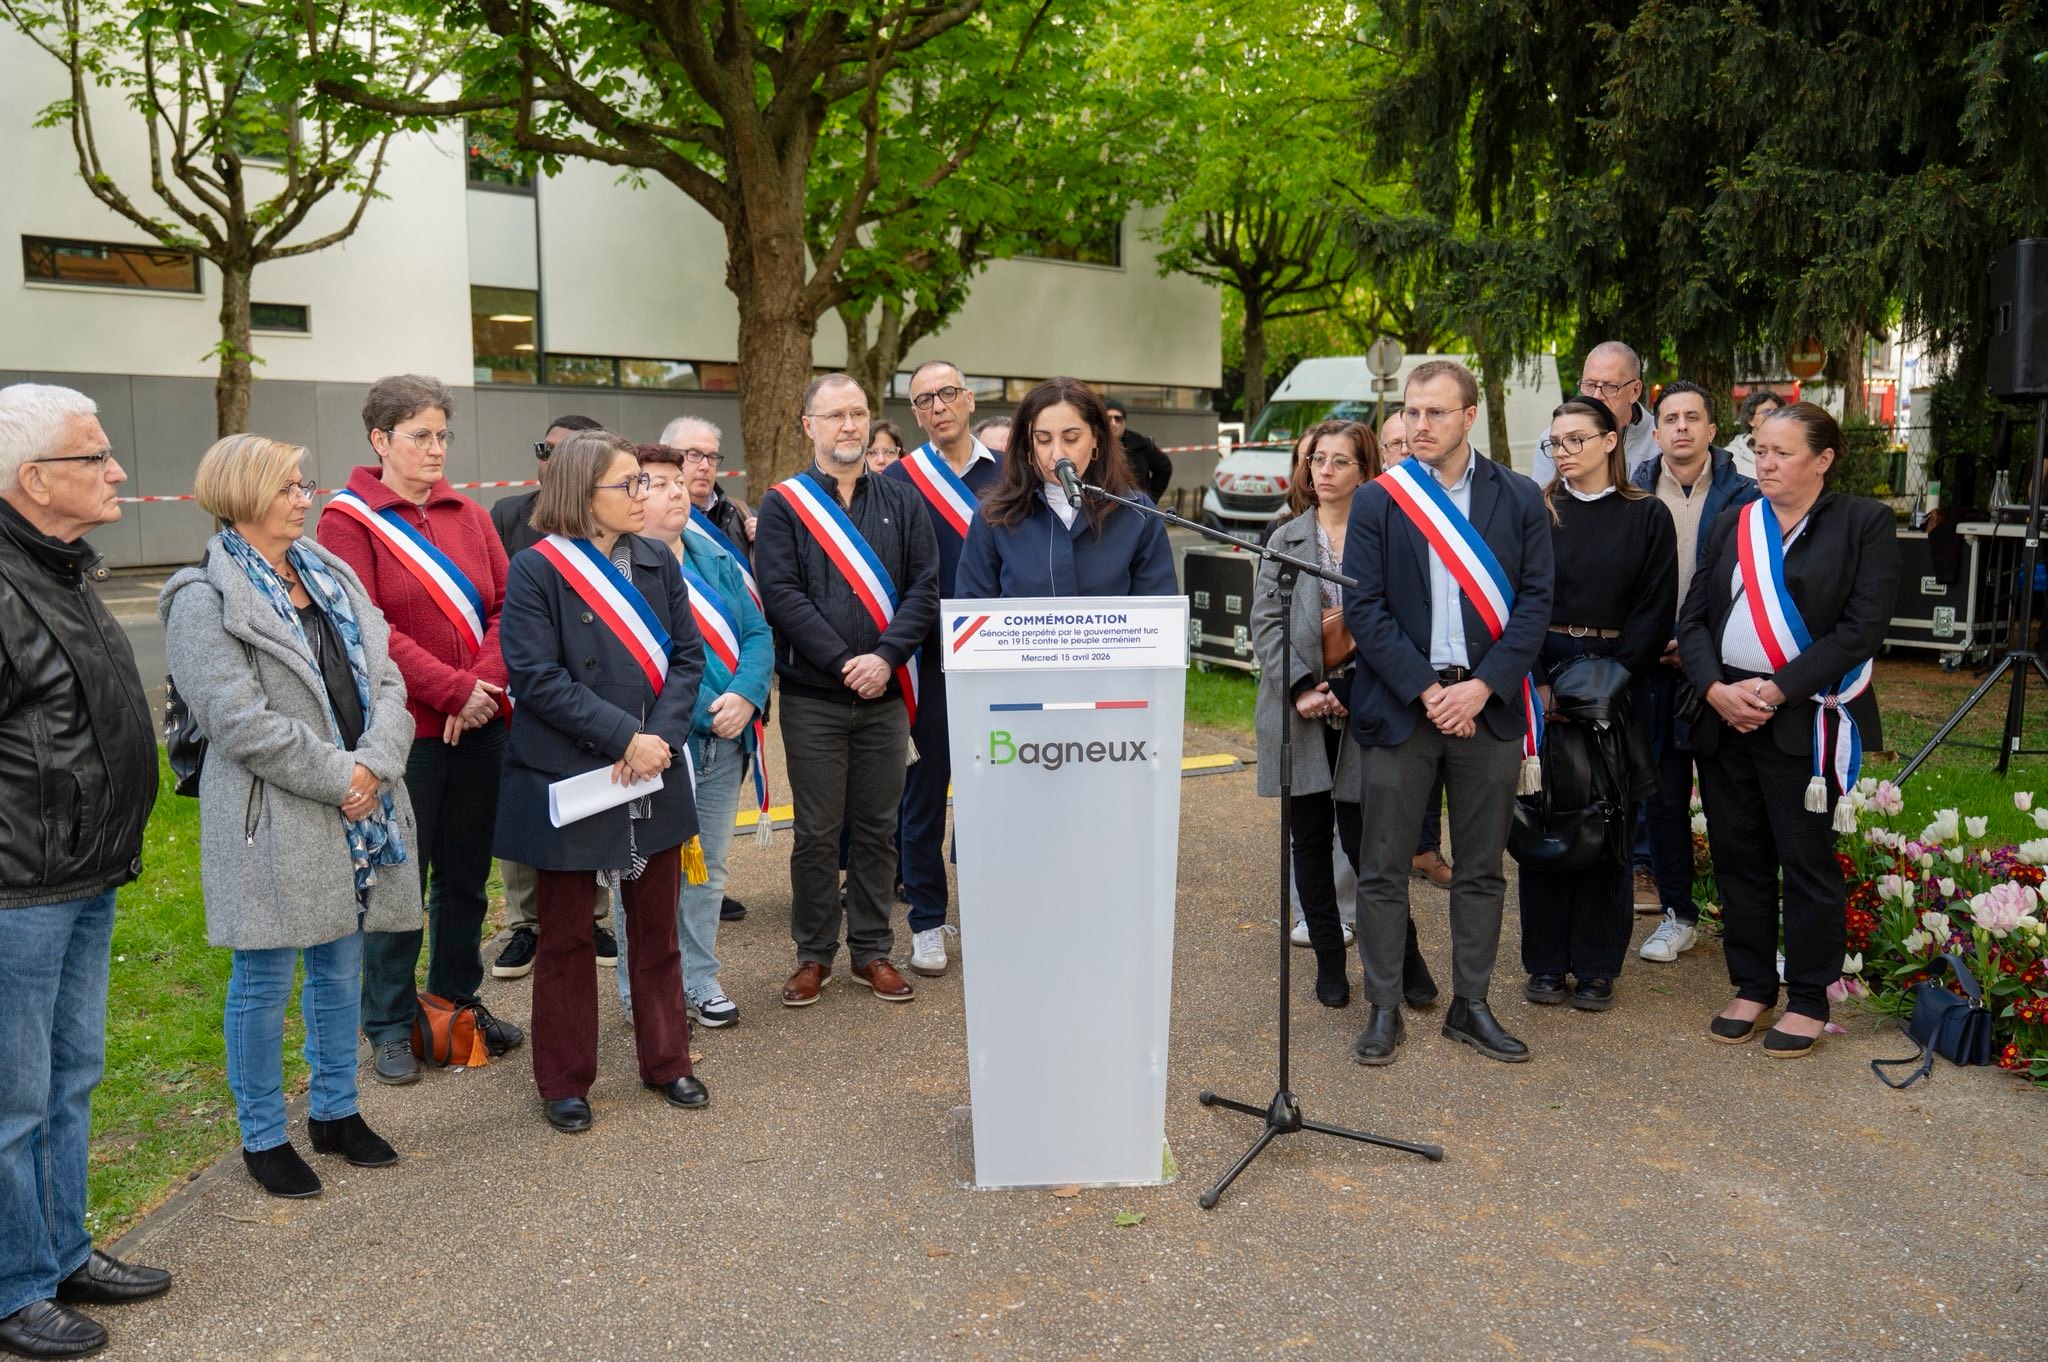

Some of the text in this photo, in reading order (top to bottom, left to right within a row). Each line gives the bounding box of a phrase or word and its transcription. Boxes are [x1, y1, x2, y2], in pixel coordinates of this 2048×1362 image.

[1004, 614, 1127, 626] COMMÉMORATION
[979, 629, 1020, 638] Génocide
[1022, 628, 1056, 638] perpétré
[1058, 630, 1072, 638] par
[1074, 628, 1082, 636] le
[1083, 628, 1142, 638] gouvernement
[1012, 638, 1030, 646] 1915
[1032, 637, 1059, 645] contre
[1060, 637, 1068, 645] le
[1070, 636, 1100, 646] peuple
[1102, 636, 1141, 644] arménien
[1021, 652, 1110, 662] Mercredi 15 avril 2026
[990, 730, 1147, 771] Bagneux
